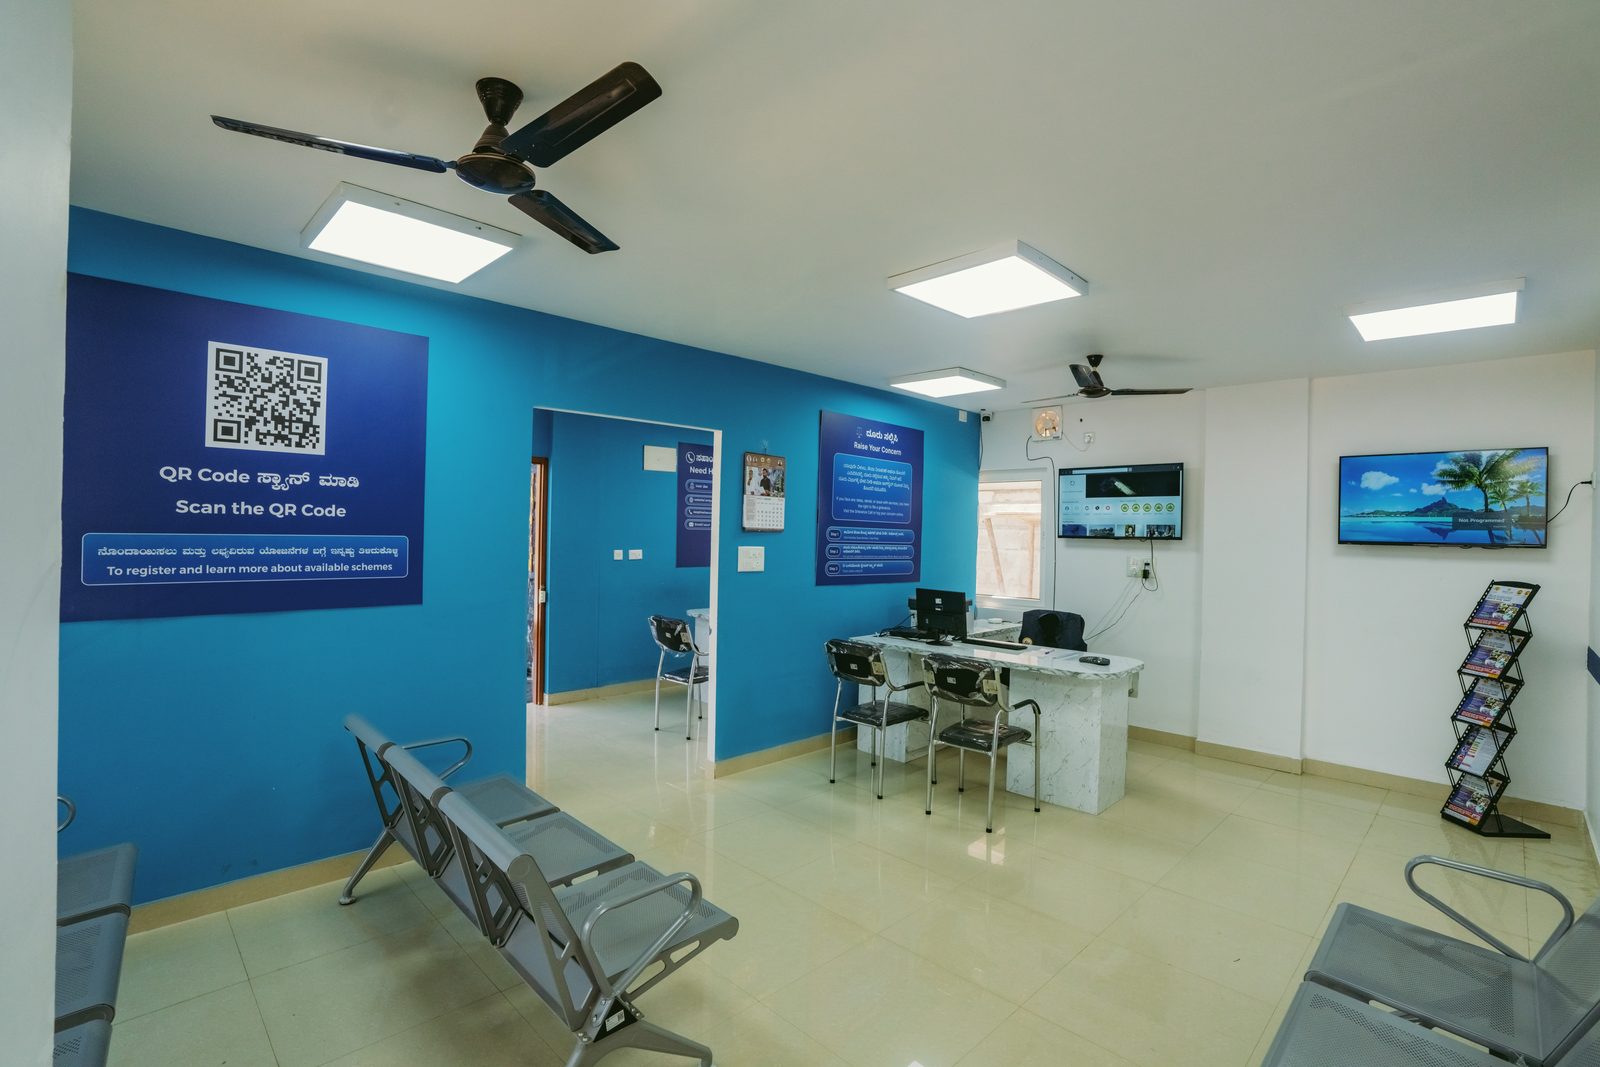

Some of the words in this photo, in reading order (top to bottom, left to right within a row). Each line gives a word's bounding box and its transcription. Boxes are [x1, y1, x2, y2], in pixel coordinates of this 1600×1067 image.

[865, 428, 883, 440] ದೂರು
[853, 441, 868, 451] Raise
[869, 444, 880, 452] Your
[881, 446, 902, 456] Concern
[689, 466, 707, 475] Need
[159, 466, 192, 483] QR
[198, 468, 250, 483] Code
[257, 471, 310, 491] ಸ್ಕ್ಯಾನ್
[319, 473, 360, 488] ಮಾಡಿ
[175, 499, 226, 514] Scan
[231, 501, 264, 515] the
[269, 503, 297, 518] QR
[301, 504, 347, 517] Code
[182, 547, 207, 558] ಮತ್ತು
[211, 547, 255, 559] ಲಭ್ಯವಿರುವ
[312, 546, 327, 558] ಬಗ್ಗೆ
[107, 566, 123, 576] To
[126, 565, 177, 577] register
[179, 564, 203, 575] and
[206, 564, 236, 574] learn
[238, 564, 268, 573] more
[270, 563, 302, 573] about
[304, 563, 350, 572] available
[351, 562, 393, 571] schemes
